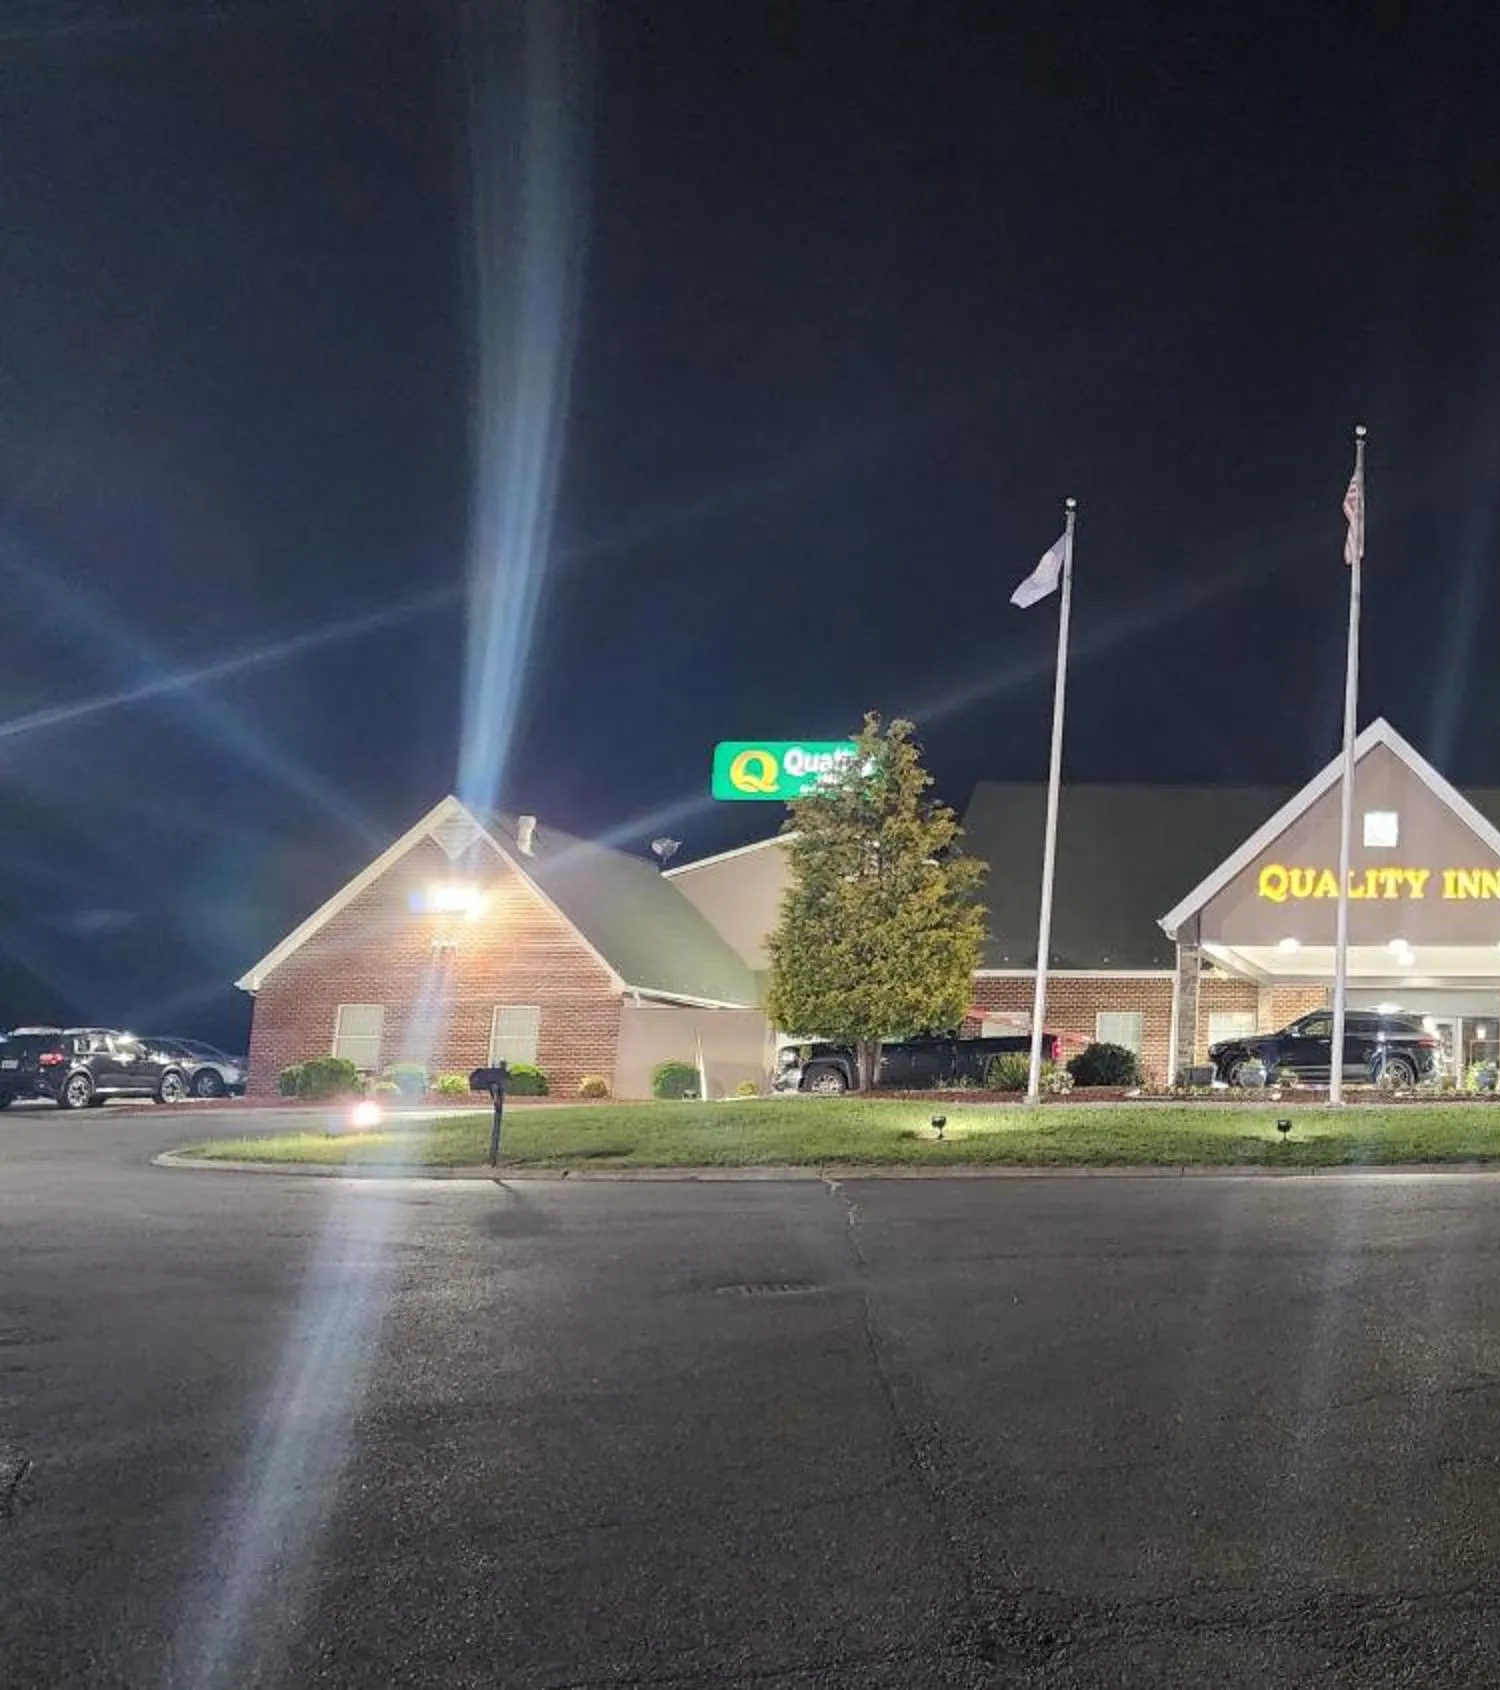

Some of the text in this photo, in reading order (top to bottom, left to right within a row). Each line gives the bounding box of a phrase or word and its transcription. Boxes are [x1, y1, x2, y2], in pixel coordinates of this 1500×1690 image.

[730, 750, 779, 792] Q
[783, 747, 875, 777] Qual
[1258, 864, 1430, 902] QUALITY
